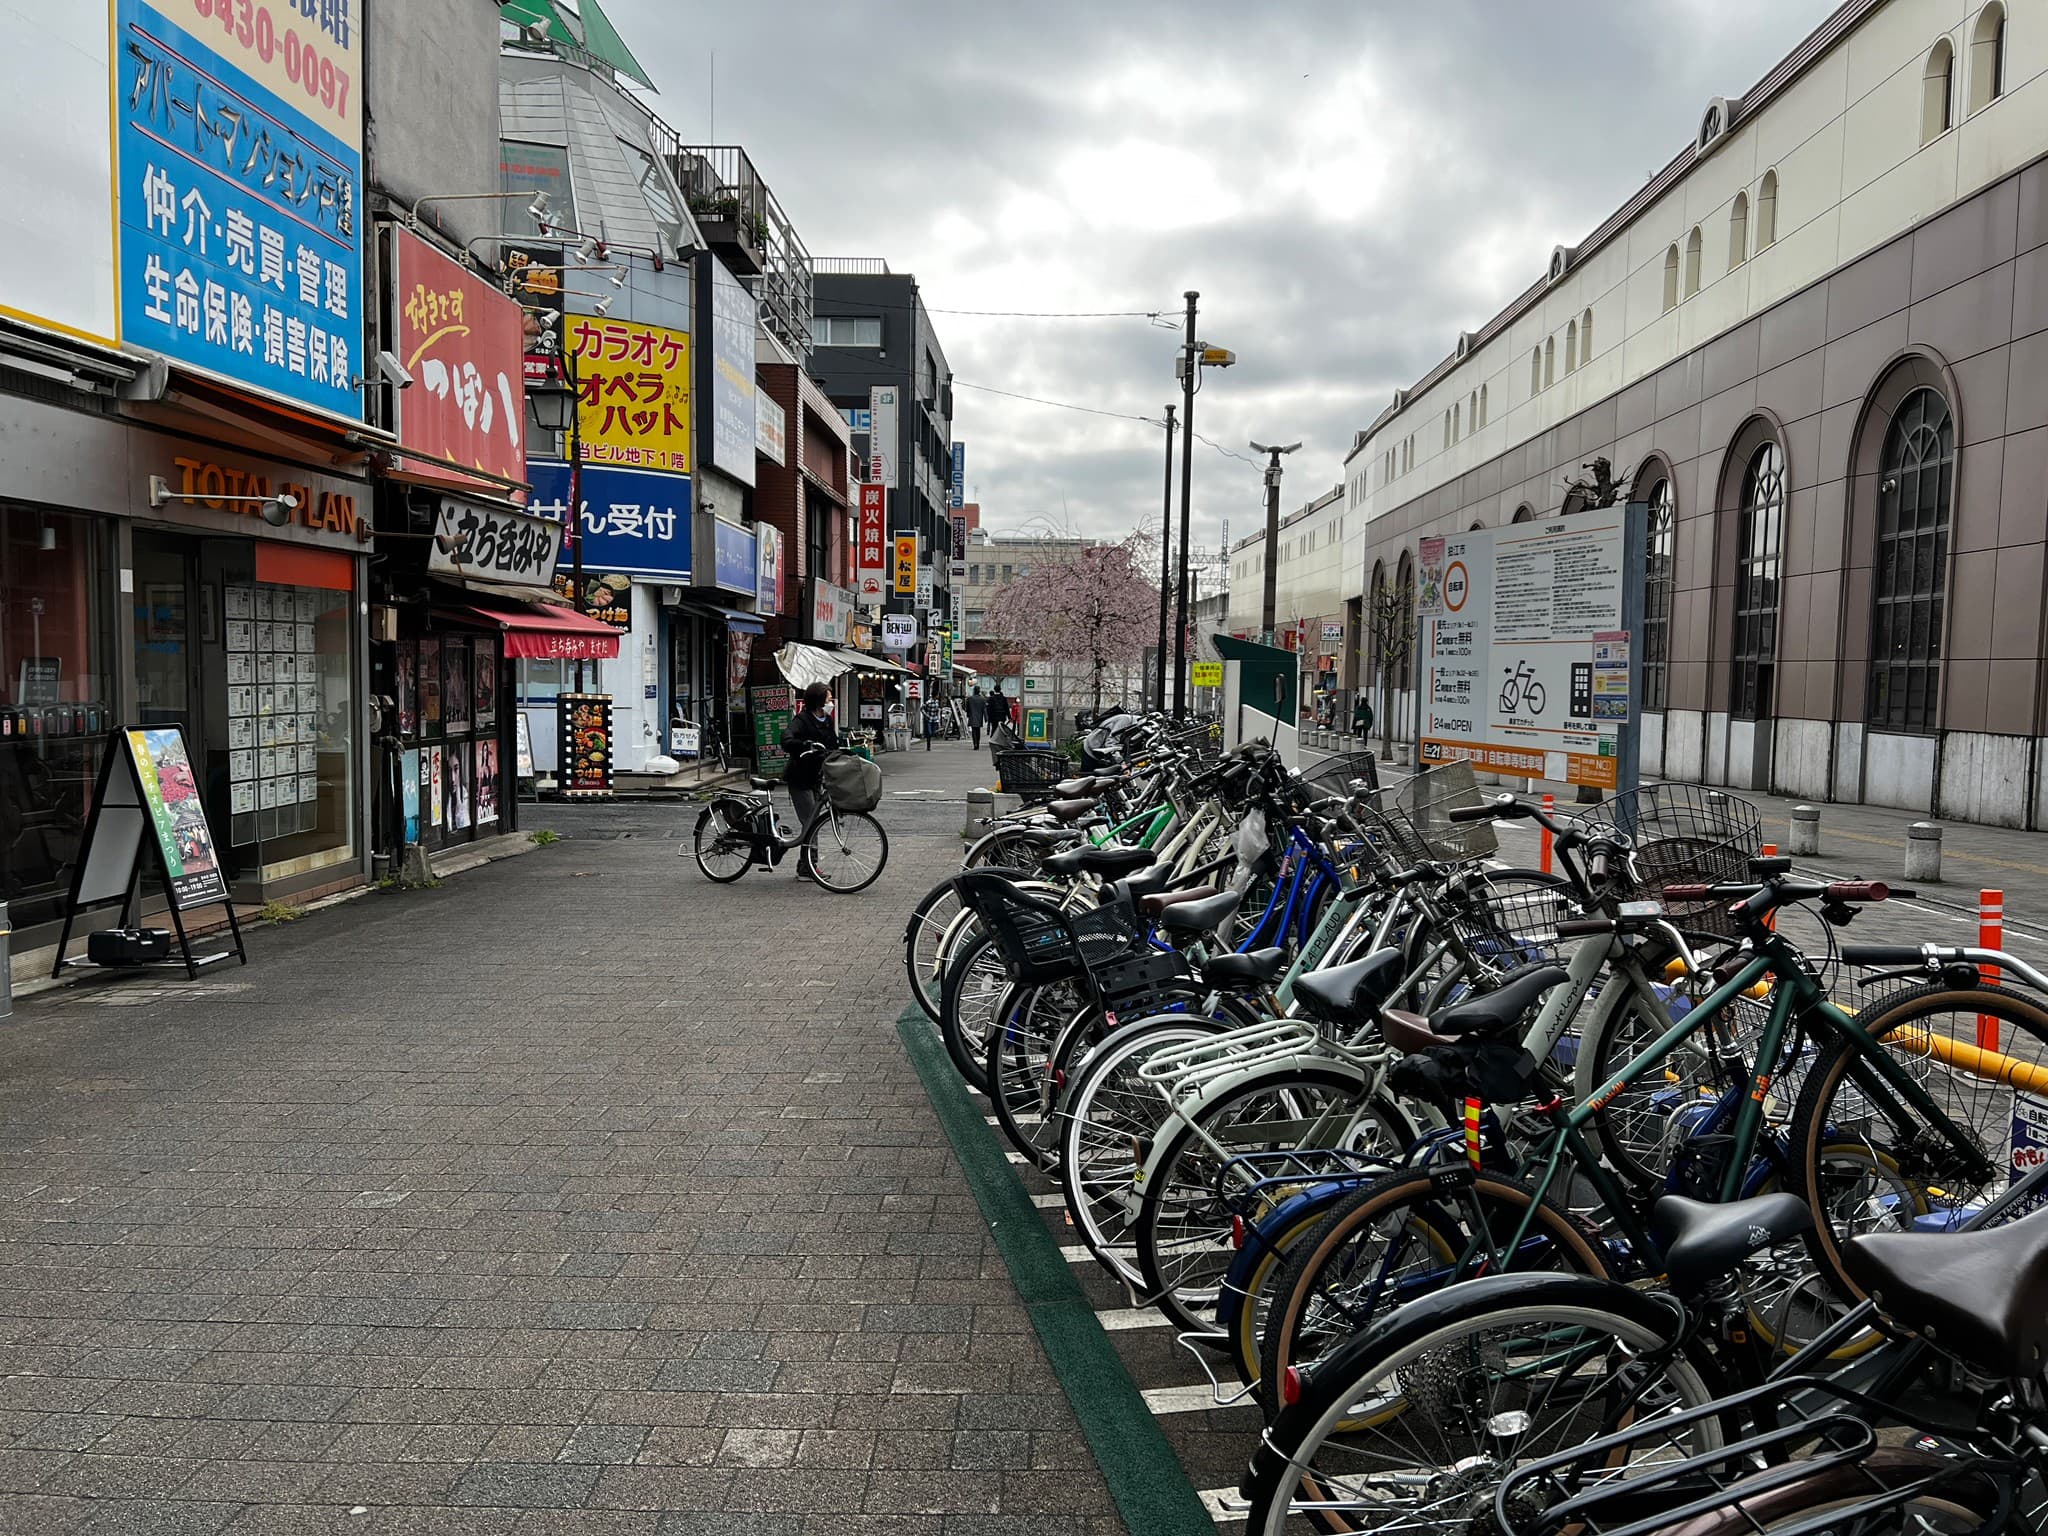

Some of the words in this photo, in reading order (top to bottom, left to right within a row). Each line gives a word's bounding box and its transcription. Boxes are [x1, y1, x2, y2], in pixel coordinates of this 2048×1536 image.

[142, 159, 349, 321] 仲介・売買・管理
[143, 253, 350, 393] 生命保険・損害保険
[405, 283, 465, 335] 好きです
[573, 320, 685, 371] カラオケ
[421, 358, 519, 448] つぼ八
[576, 371, 665, 408] オペラ
[599, 402, 685, 437] ハット
[872, 455, 881, 481] HOME
[282, 481, 357, 534] PLAN
[864, 489, 880, 562] 炭火焼肉
[898, 560, 911, 587] 松屋
[1447, 581, 1464, 593] 自転車
[585, 606, 629, 622] つけ麺
[1308, 912, 1342, 963] APPLAUD
[1545, 976, 1583, 1042] Antelope
